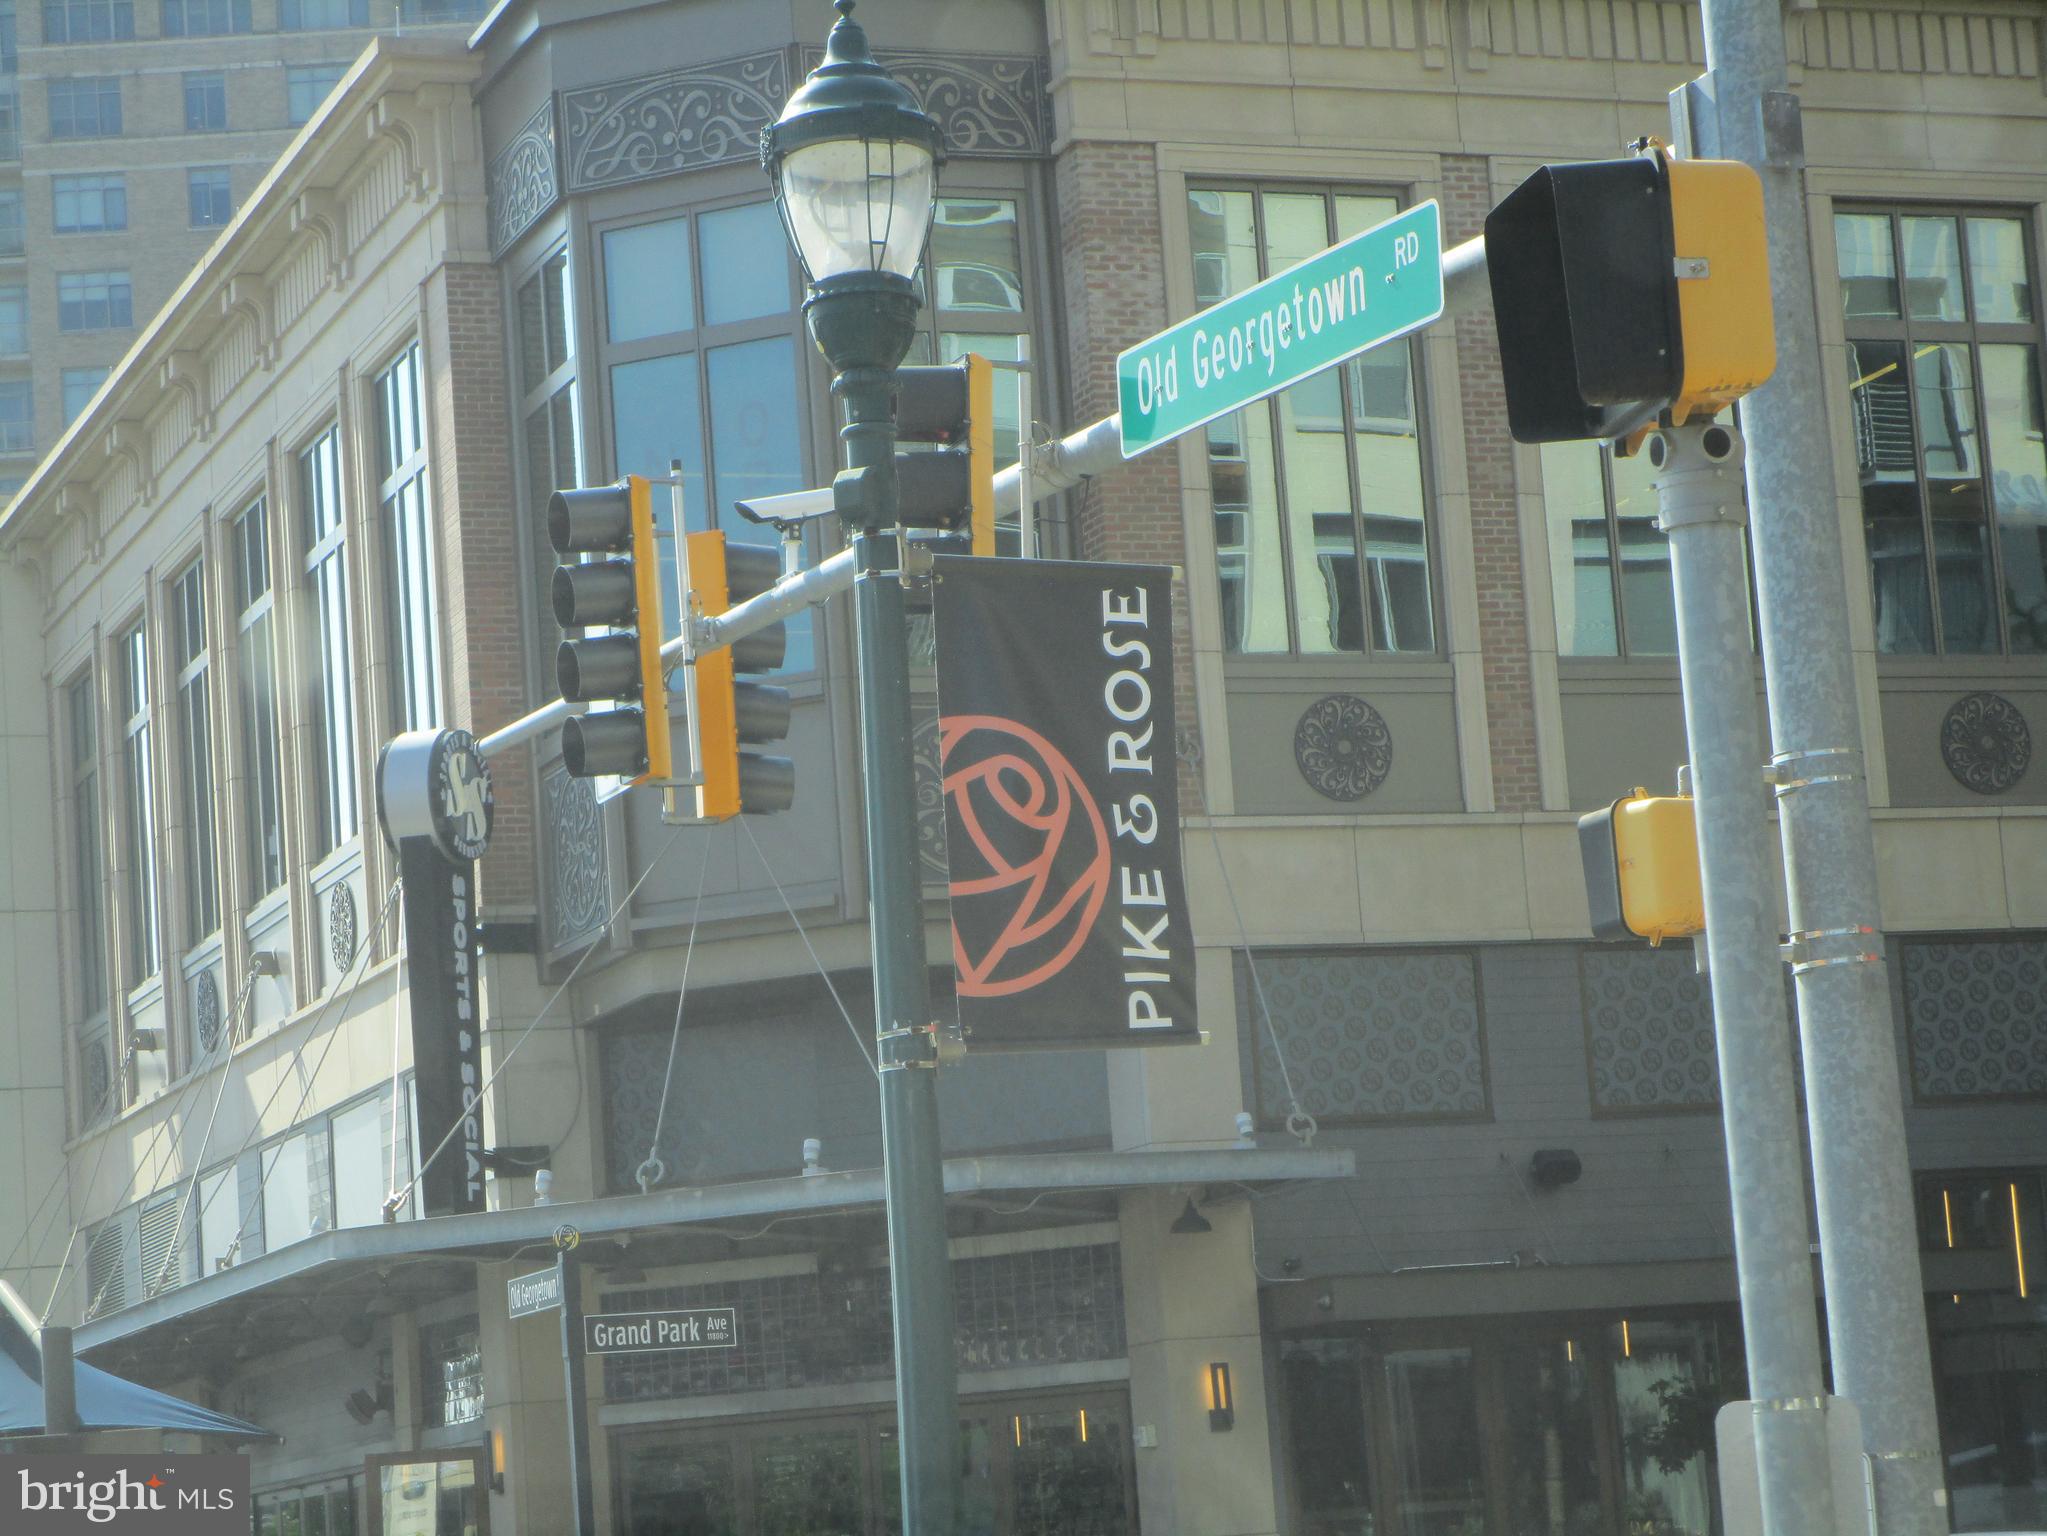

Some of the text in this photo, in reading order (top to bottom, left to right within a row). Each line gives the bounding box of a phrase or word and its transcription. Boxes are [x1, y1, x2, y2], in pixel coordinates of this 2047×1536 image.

[1137, 231, 1420, 415] Old Georgetown RD
[1101, 585, 1173, 1029] PIKE & ROSE
[460, 1061, 481, 1202] SOCIAL
[510, 1283, 521, 1310] Old
[521, 1277, 558, 1309] Georgetown
[594, 1316, 727, 1347] Grand Park Ave
